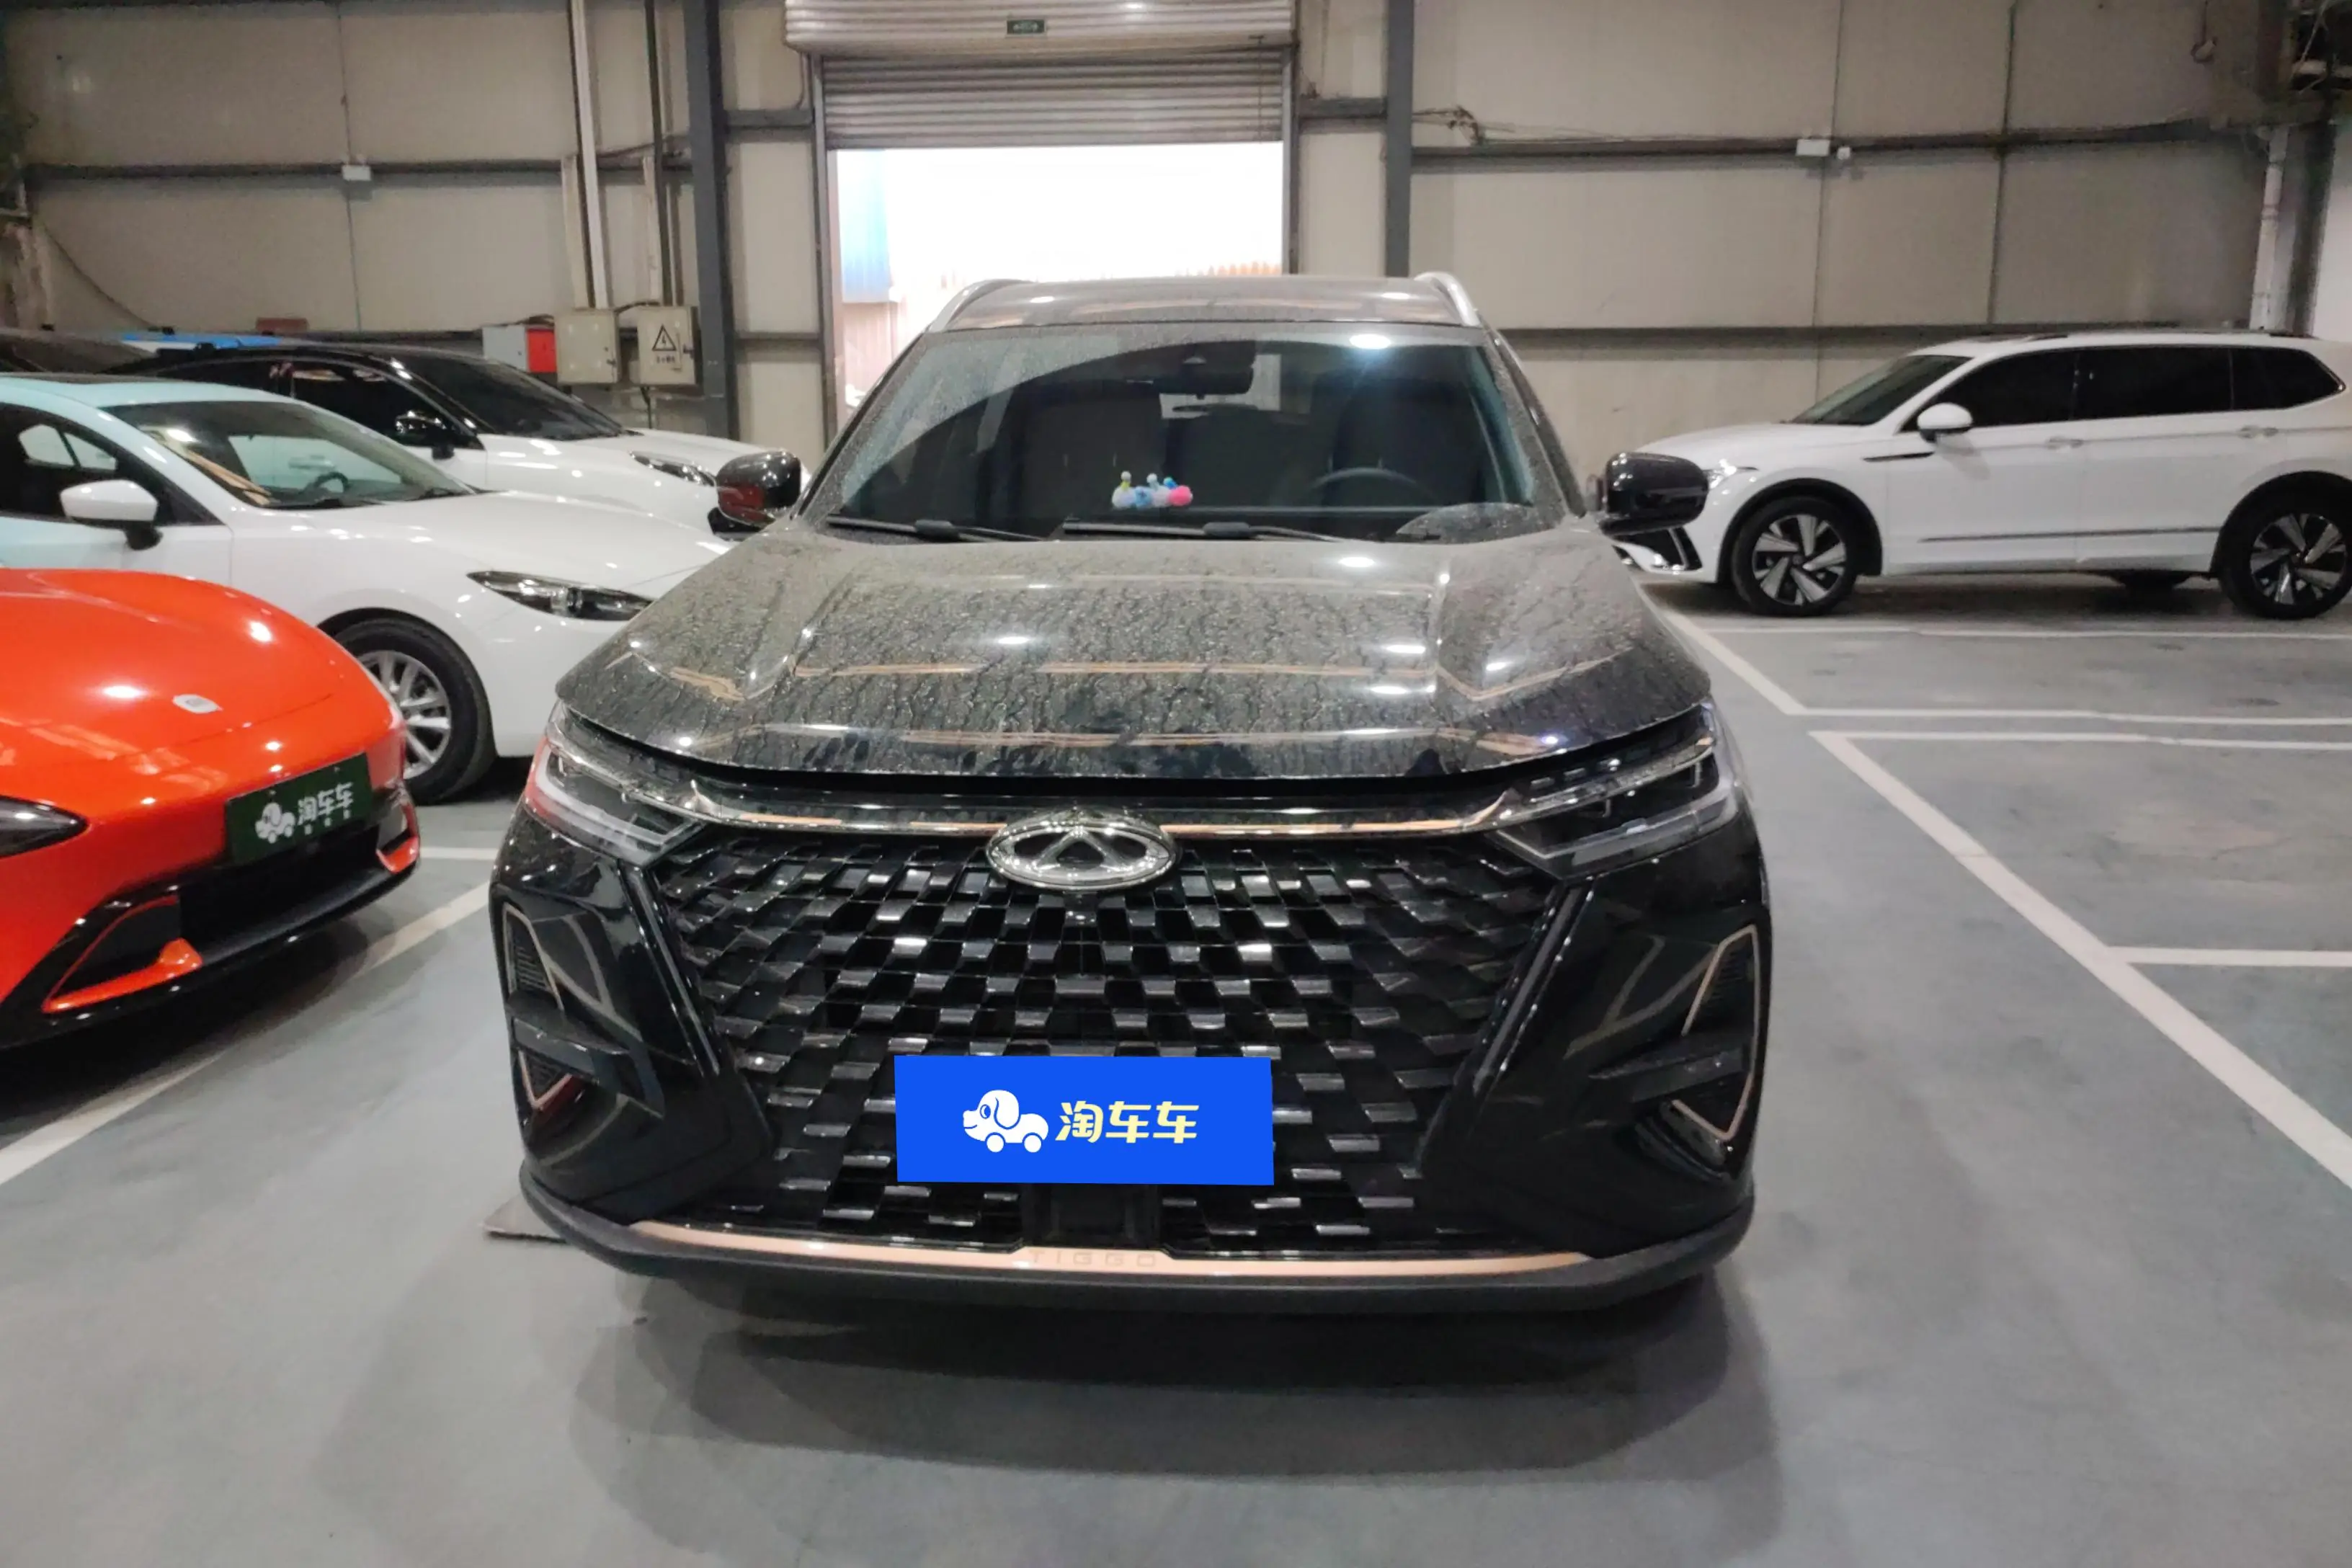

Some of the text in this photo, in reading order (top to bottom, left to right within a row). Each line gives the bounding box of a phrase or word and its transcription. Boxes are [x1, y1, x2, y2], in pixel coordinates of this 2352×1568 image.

[298, 782, 354, 825] 淘车车
[1029, 1250, 1157, 1268] TIGGO
